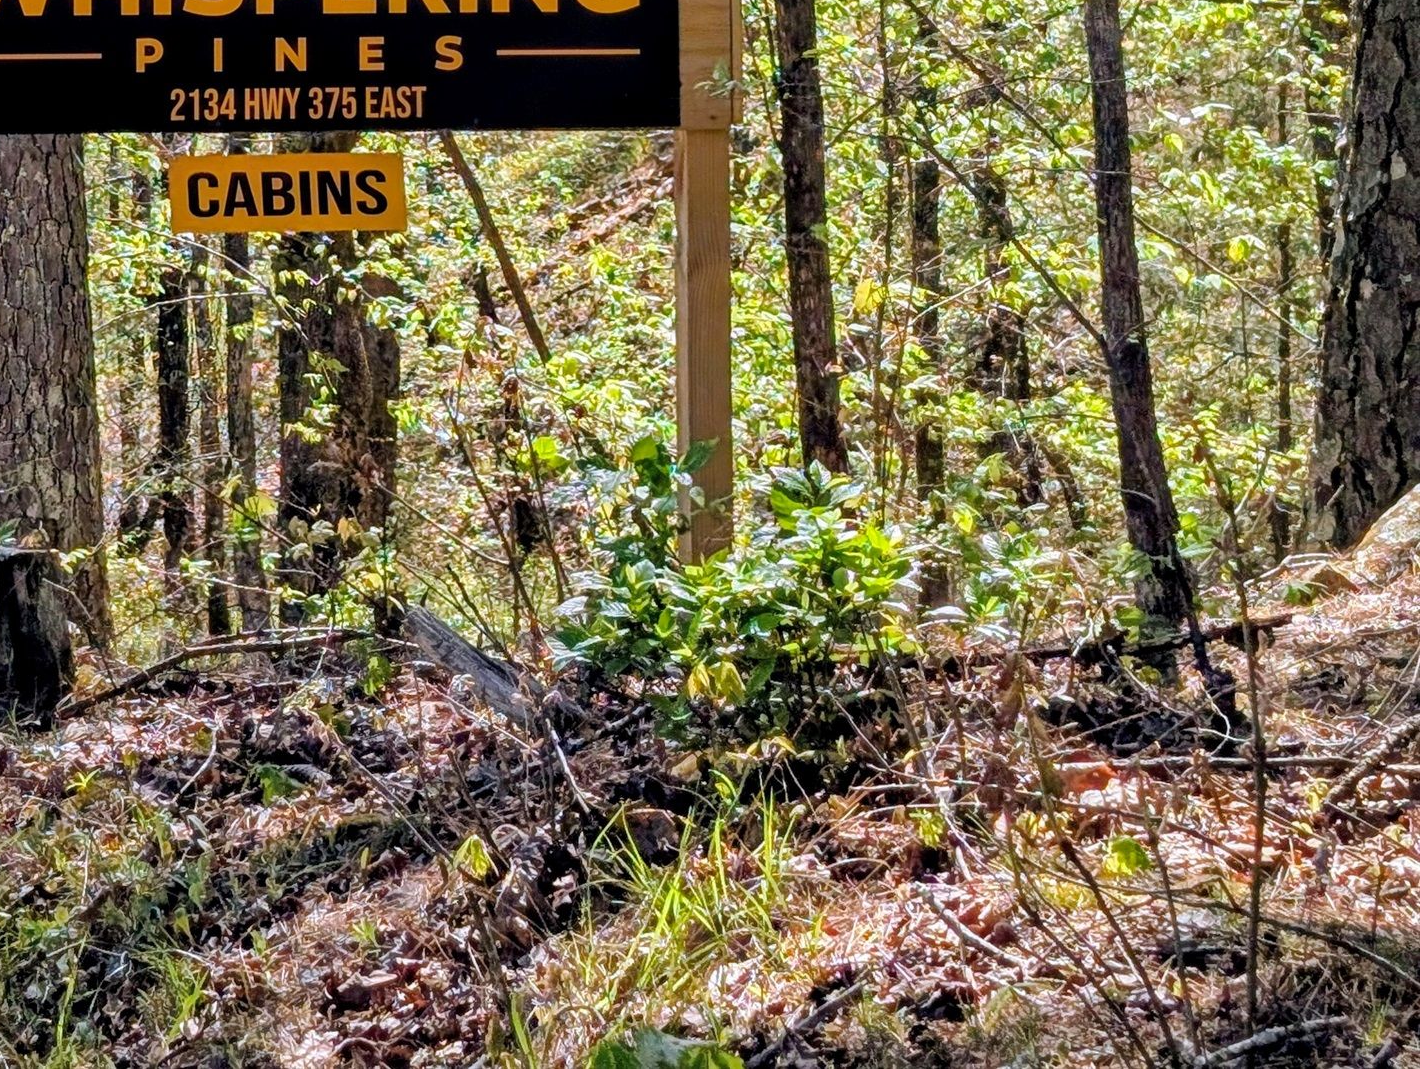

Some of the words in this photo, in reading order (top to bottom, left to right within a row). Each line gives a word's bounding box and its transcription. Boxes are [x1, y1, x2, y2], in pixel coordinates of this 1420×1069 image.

[170, 88, 237, 121] 2134
[244, 87, 300, 120] HWY
[308, 87, 358, 119] 375
[365, 85, 427, 119] EAST
[186, 169, 388, 218] CABINS
